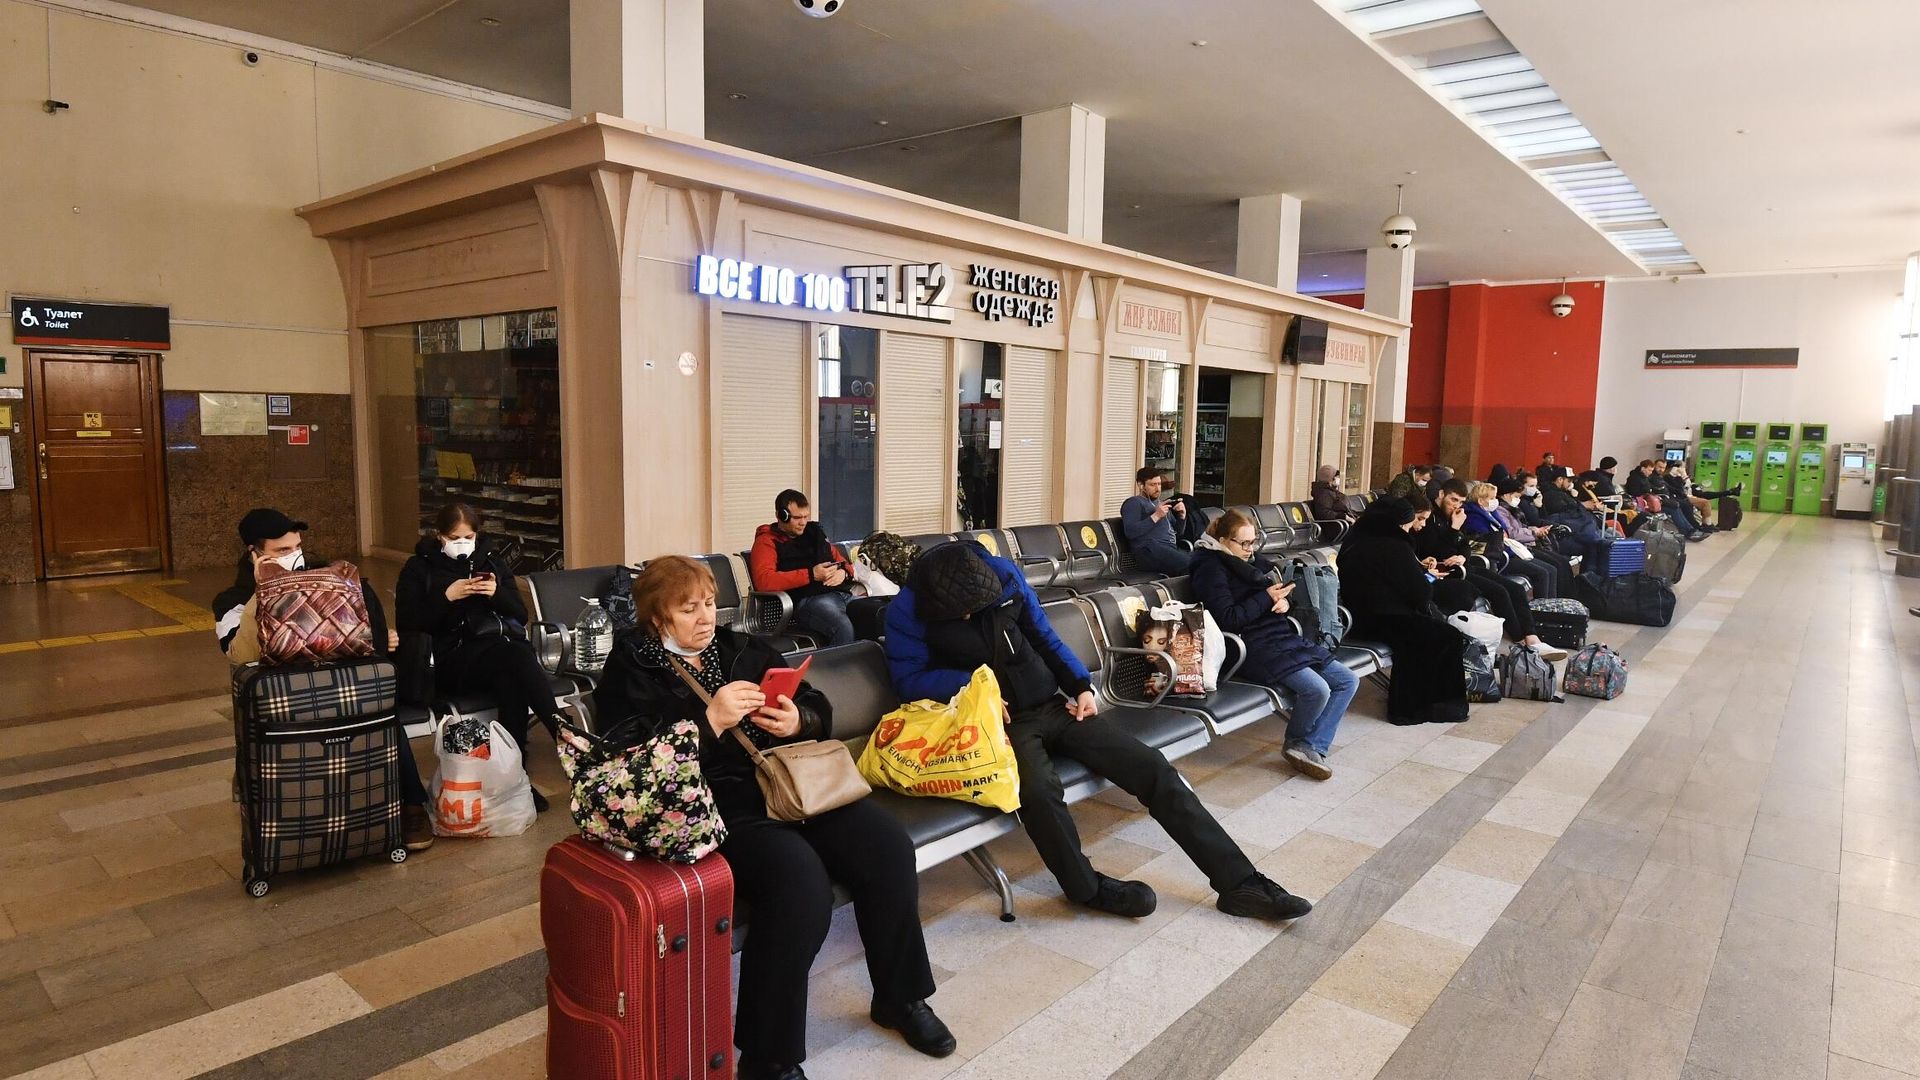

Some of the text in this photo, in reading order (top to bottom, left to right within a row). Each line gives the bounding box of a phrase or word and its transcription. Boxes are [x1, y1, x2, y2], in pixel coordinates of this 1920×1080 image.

[696, 254, 845, 313] ВСЕ ПО 100
[844, 263, 955, 324] TELE2
[968, 264, 1060, 300] женская
[43, 307, 84, 320] Туалет
[45, 320, 69, 329] Toilet
[972, 291, 1056, 328] одежда
